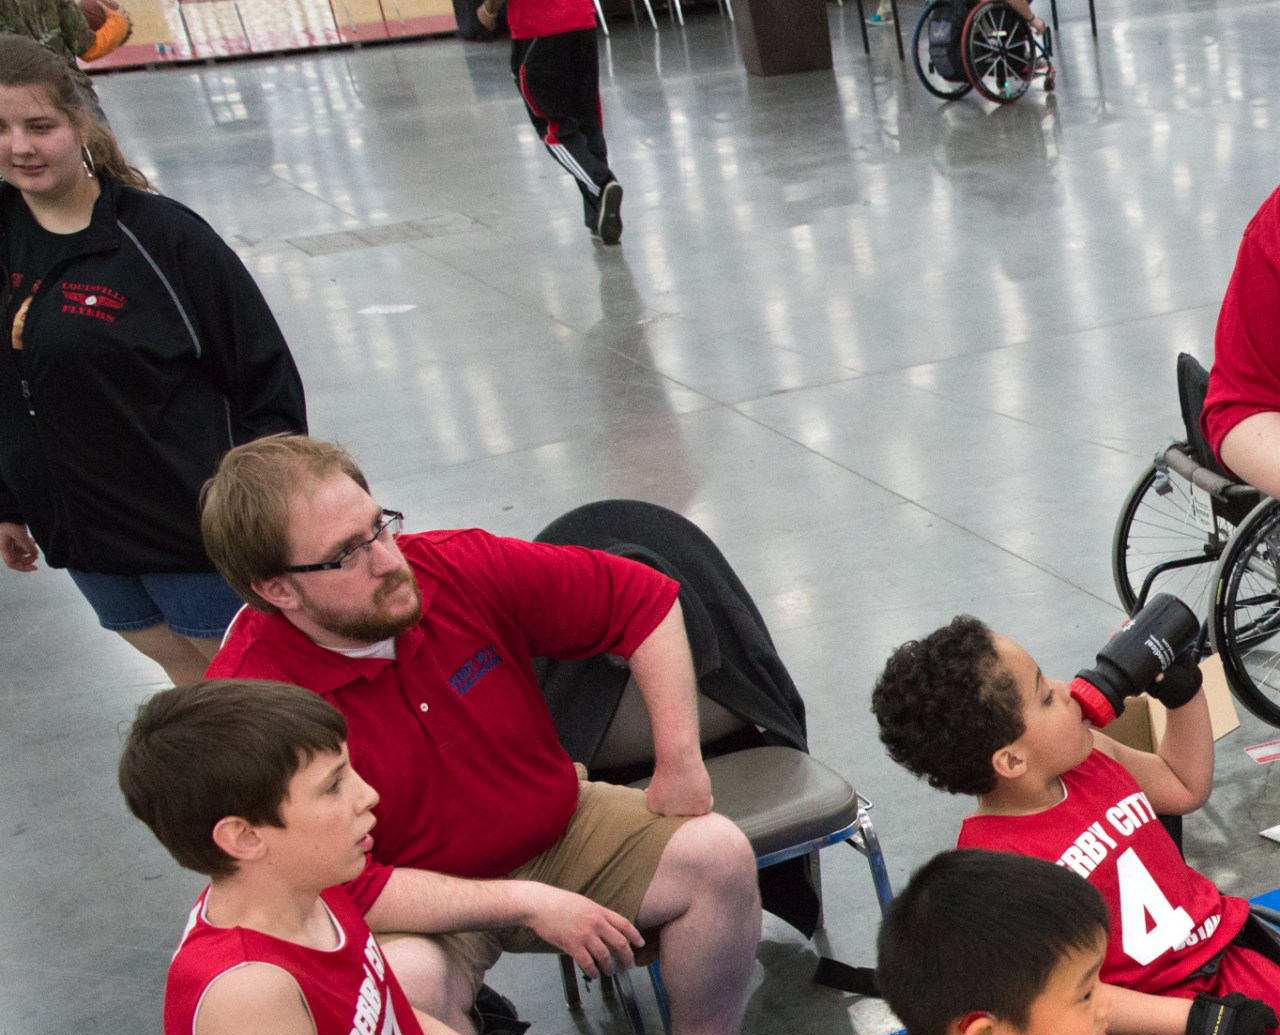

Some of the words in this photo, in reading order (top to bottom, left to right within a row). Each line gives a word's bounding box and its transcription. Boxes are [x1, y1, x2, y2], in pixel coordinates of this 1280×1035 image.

[61, 282, 128, 304] LOUISVILLE
[61, 305, 115, 322] FLYERS
[1056, 821, 1118, 880] RBY
[1116, 846, 1196, 967] 4
